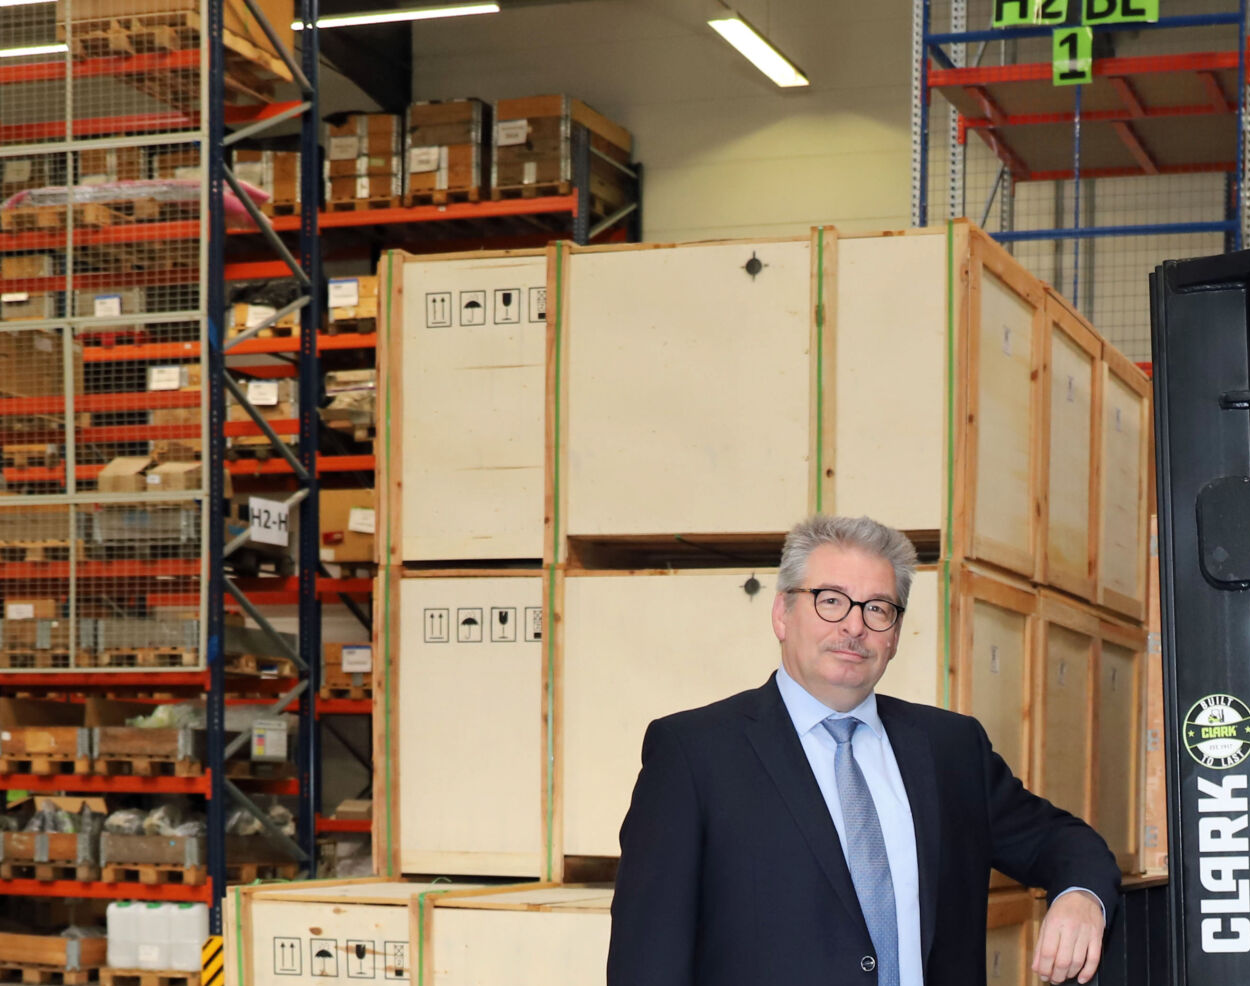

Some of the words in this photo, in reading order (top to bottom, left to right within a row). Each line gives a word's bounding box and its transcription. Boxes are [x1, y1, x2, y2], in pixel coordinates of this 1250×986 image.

[1059, 32, 1086, 80] 1
[250, 507, 288, 533] H2-H
[1199, 695, 1234, 710] BUILT
[1201, 725, 1237, 738] CLARK
[1201, 754, 1214, 766] TO
[1221, 749, 1245, 767] LAST
